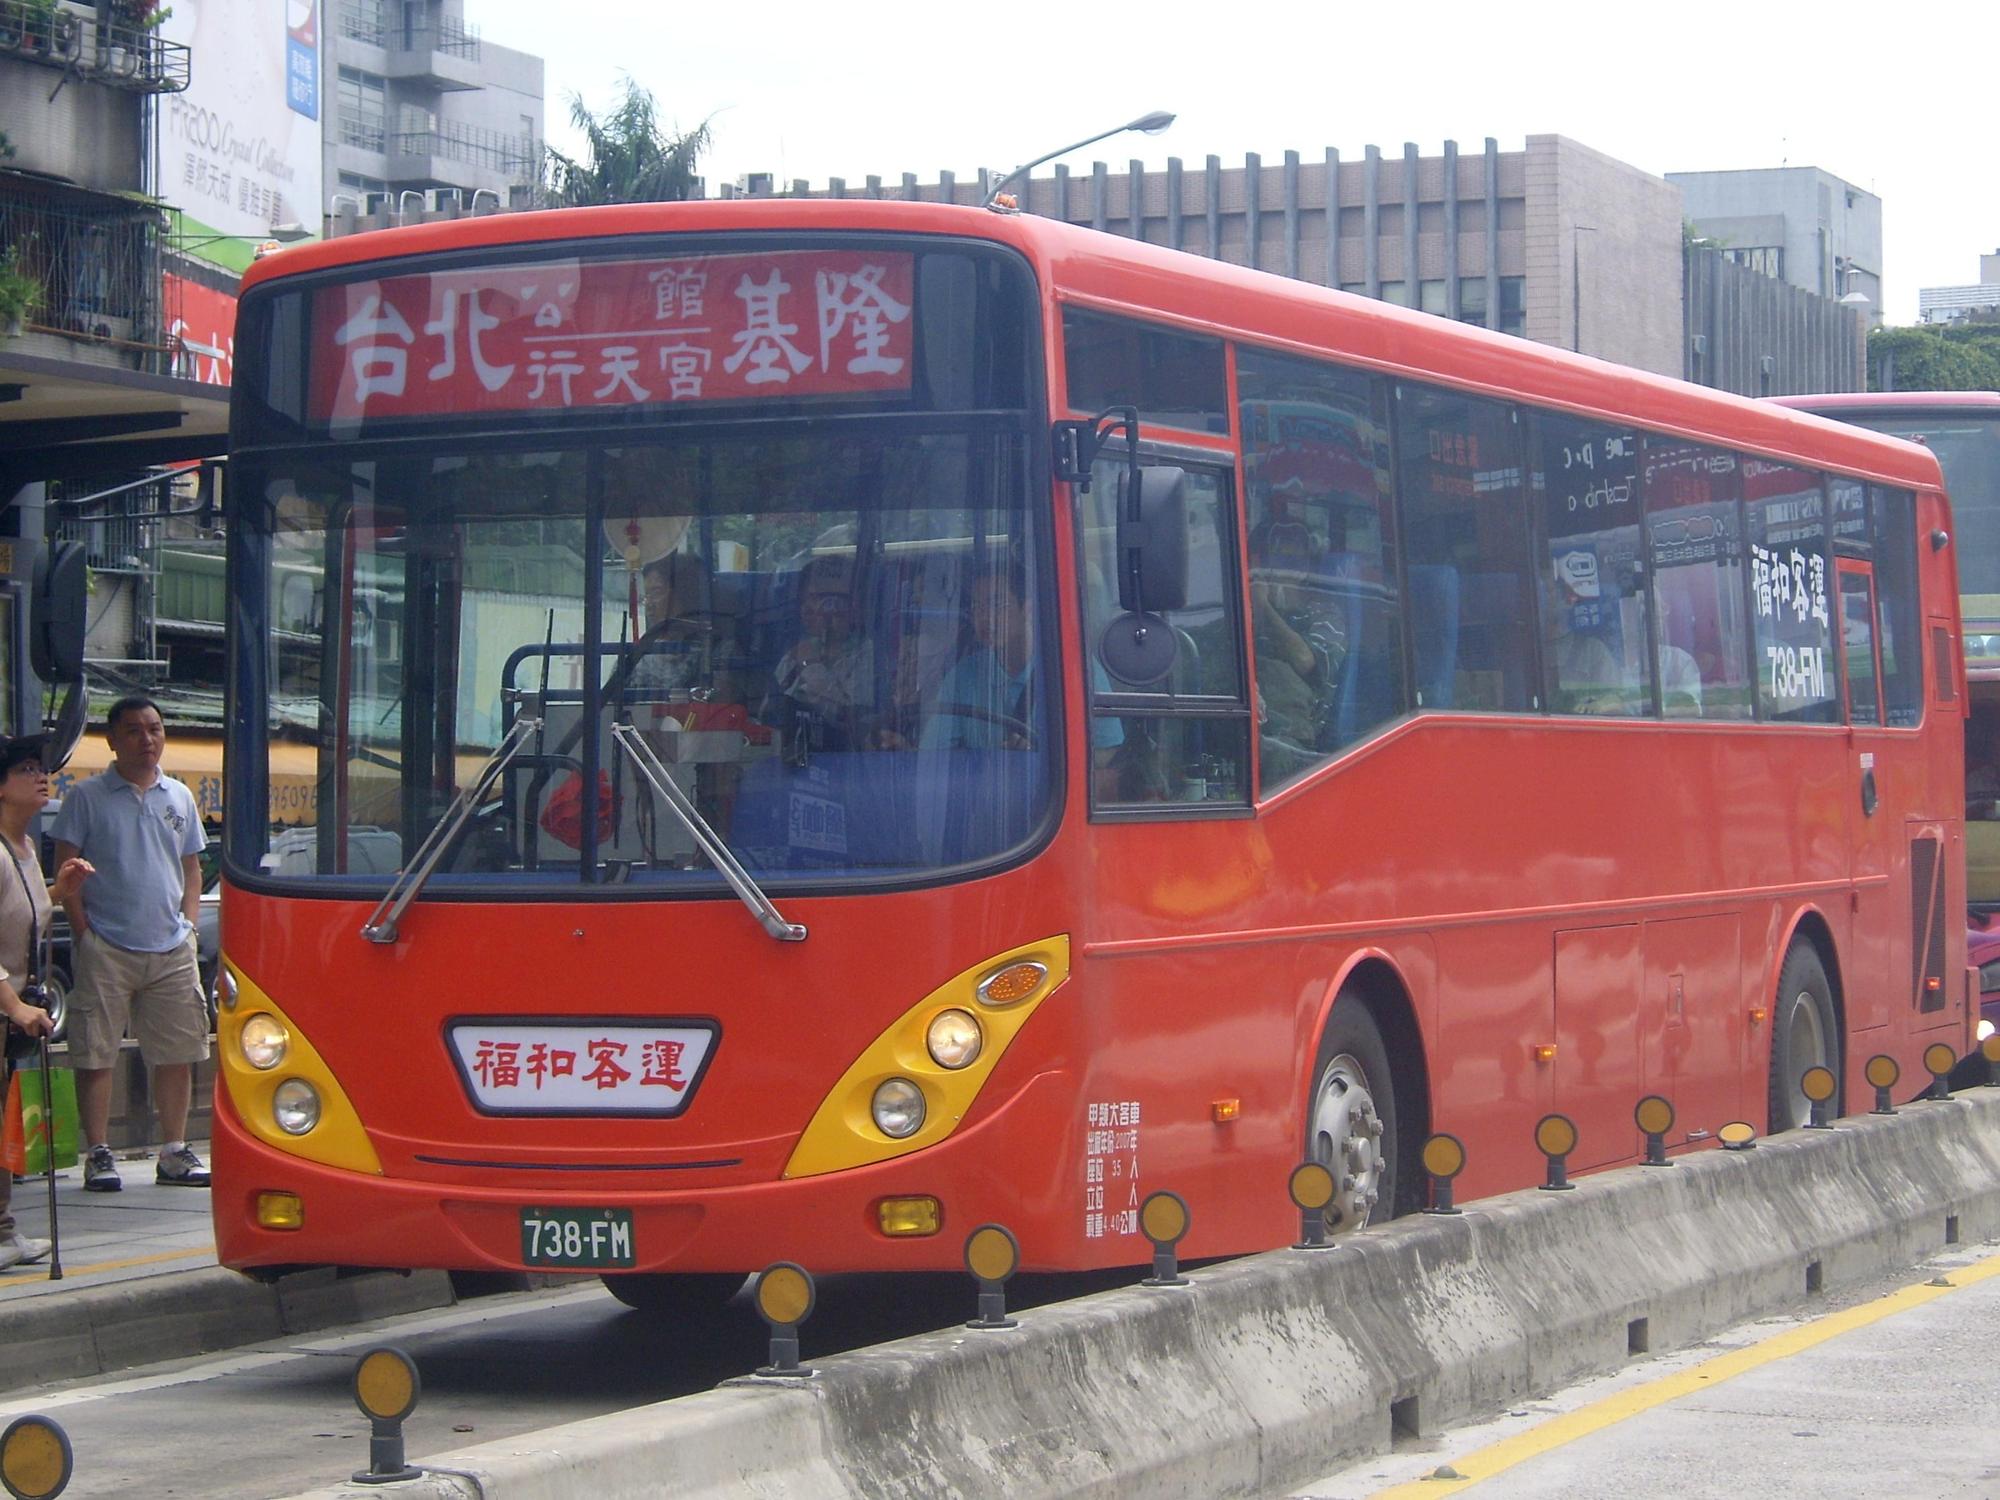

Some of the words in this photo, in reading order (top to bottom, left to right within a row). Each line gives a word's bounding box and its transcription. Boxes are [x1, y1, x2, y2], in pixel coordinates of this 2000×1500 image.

[335, 287, 515, 403] 台北
[723, 263, 912, 384] 基隆
[527, 343, 712, 405] 行天宮
[1751, 543, 1828, 628] 福和客運
[1767, 646, 1826, 699] 738-FM
[472, 1038, 687, 1093] 福和客運
[1088, 1102, 1140, 1127] 甲類大客車
[1112, 1161, 1122, 1176] 35
[1130, 1156, 1138, 1178] 人
[1087, 1186, 1103, 1209] 立位
[1129, 1183, 1138, 1205] 人
[525, 1220, 632, 1259] 738-FM
